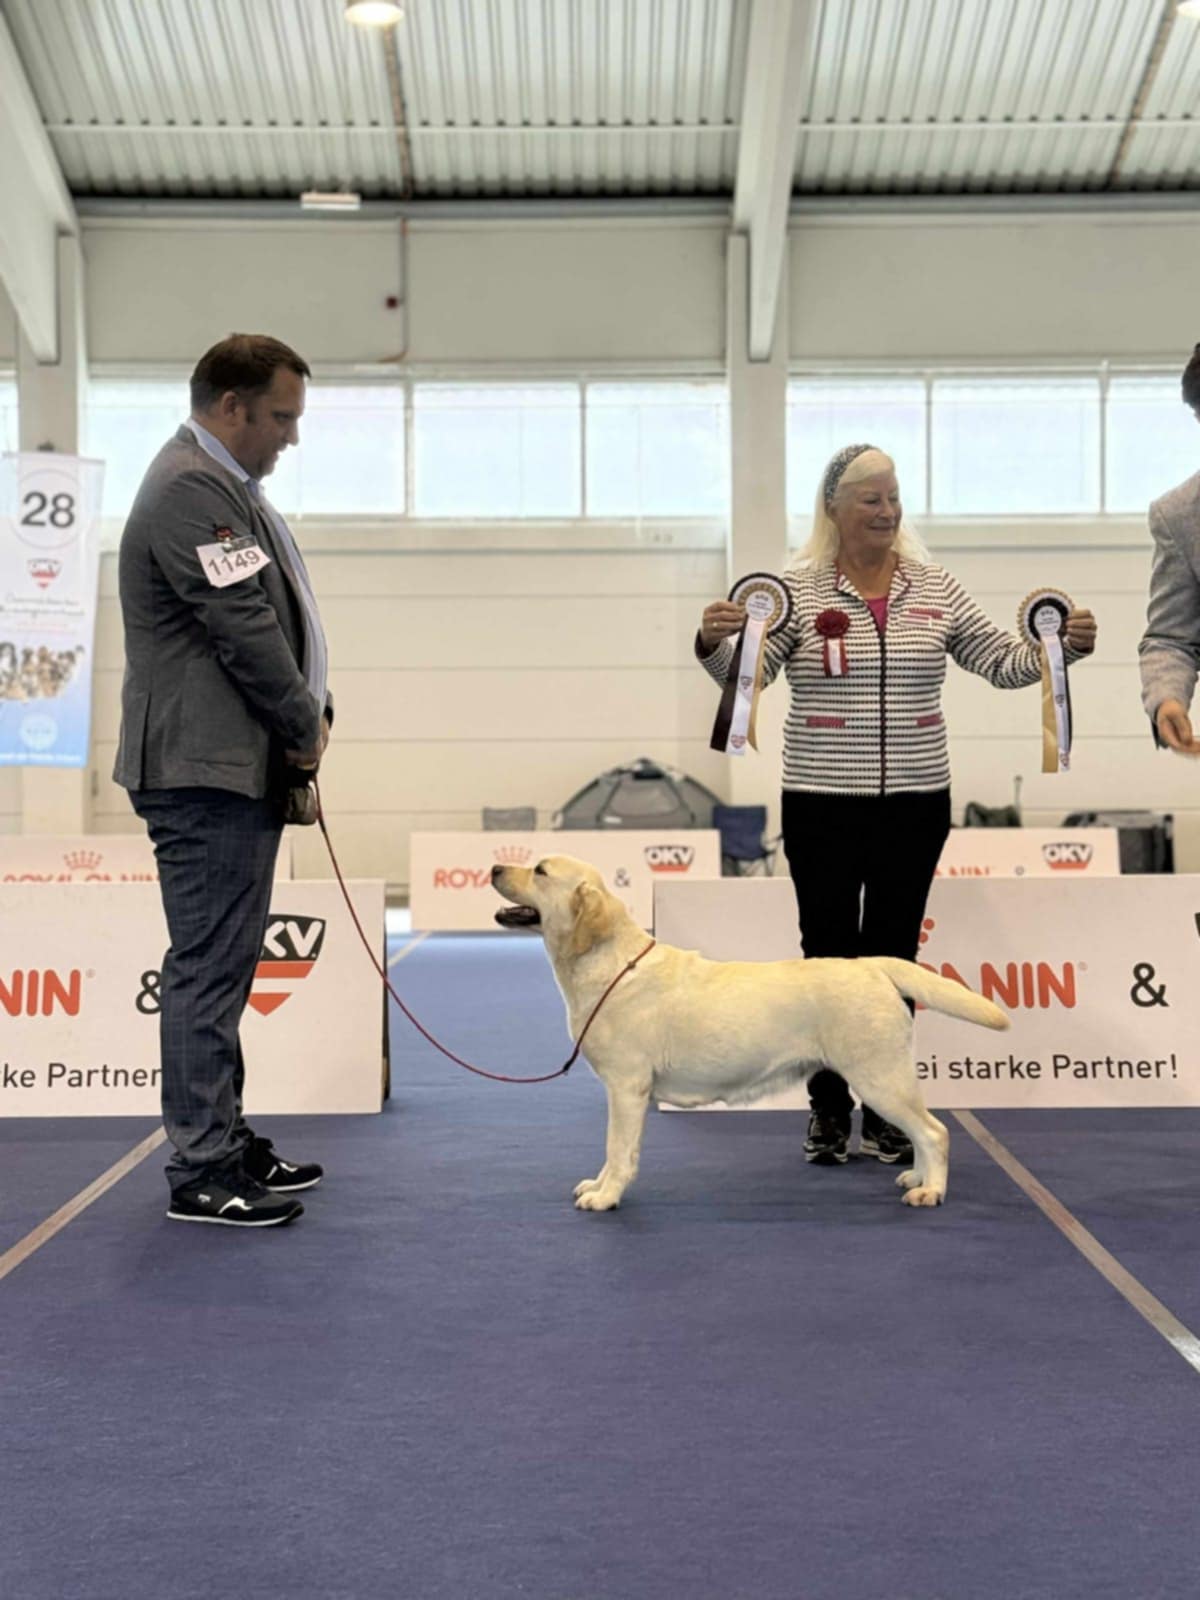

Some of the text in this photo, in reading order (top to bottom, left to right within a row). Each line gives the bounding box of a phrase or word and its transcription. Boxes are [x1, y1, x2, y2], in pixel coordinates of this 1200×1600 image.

[21, 491, 75, 528] 28
[208, 550, 260, 576] 1149
[614, 867, 631, 889] &
[136, 970, 162, 1015] &
[1130, 963, 1169, 1008] &
[0, 1062, 162, 1088] ke Partner
[948, 1055, 1042, 1080] starke
[1052, 1054, 1178, 1080] Partner!
